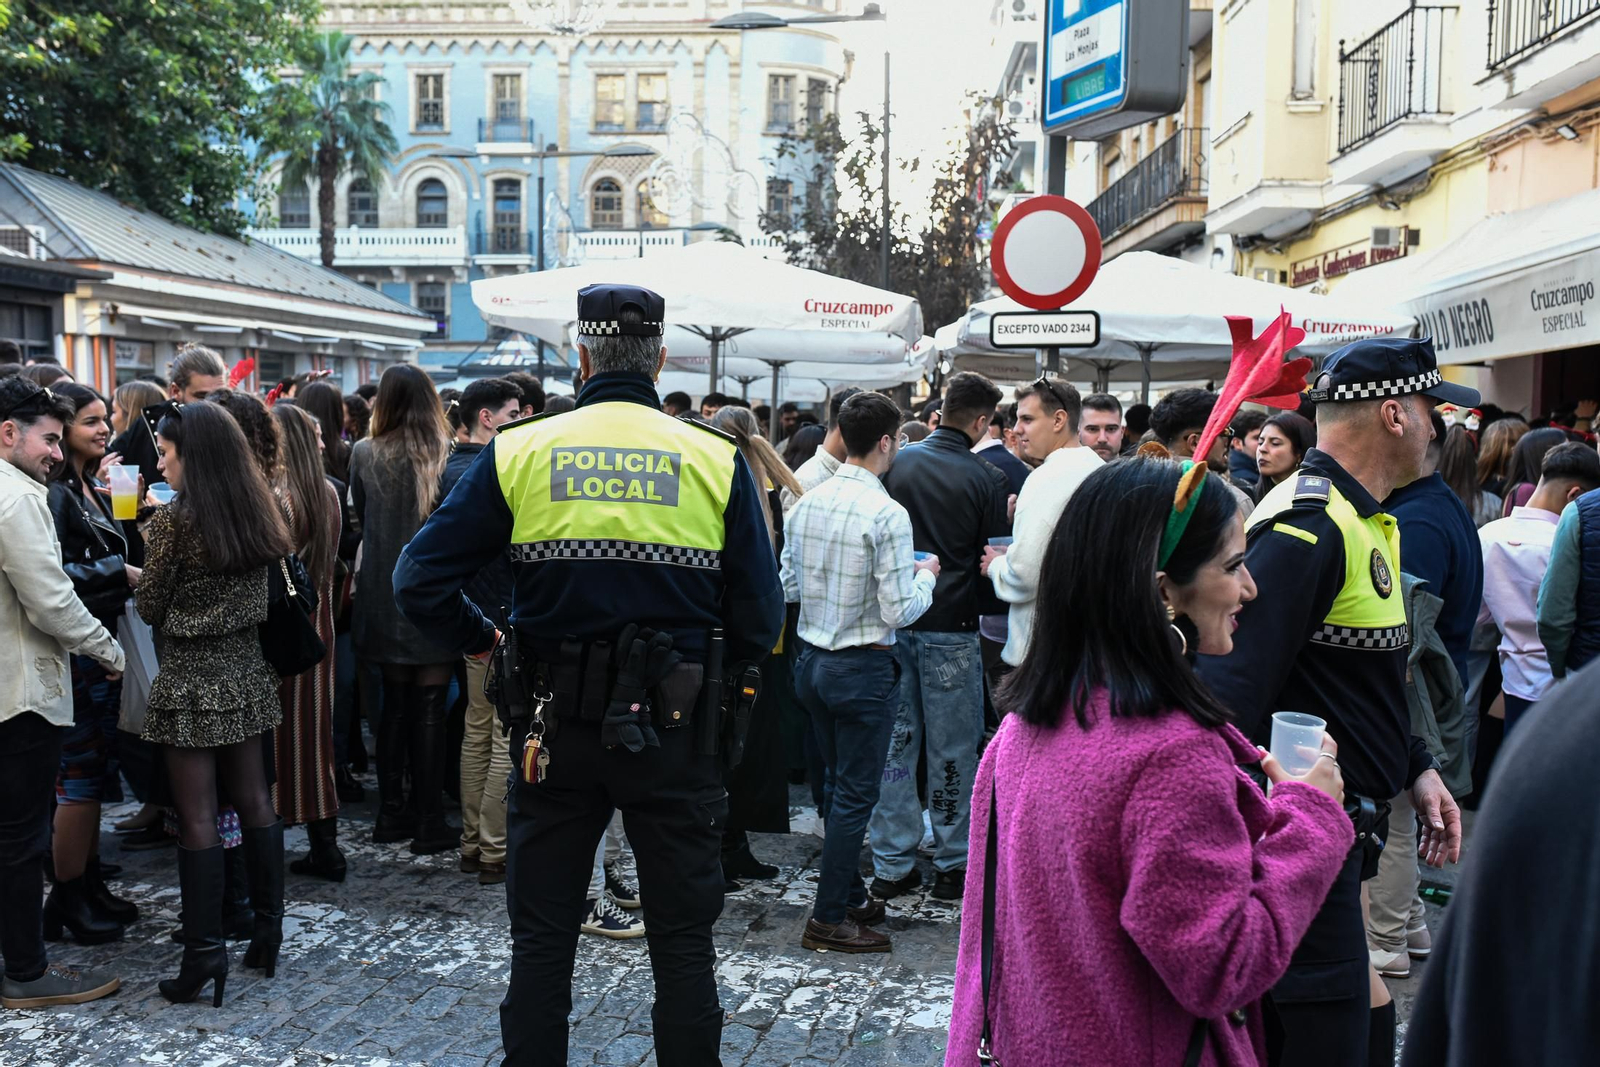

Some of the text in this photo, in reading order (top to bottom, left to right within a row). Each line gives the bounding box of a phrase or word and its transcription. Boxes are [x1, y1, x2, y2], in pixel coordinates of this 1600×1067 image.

[1073, 26, 1090, 40] Plaza
[1065, 40, 1099, 62] Las Monjas
[1531, 281, 1594, 311] Cruzcampo
[804, 299, 894, 317] Cruzcampo
[998, 323, 1091, 334] EXCEPTO VADO 2344
[1448, 297, 1494, 348] NEGRO
[1542, 310, 1587, 333] ESPECIAL
[556, 451, 674, 475] POLICIA
[566, 477, 662, 501] LOCAL
